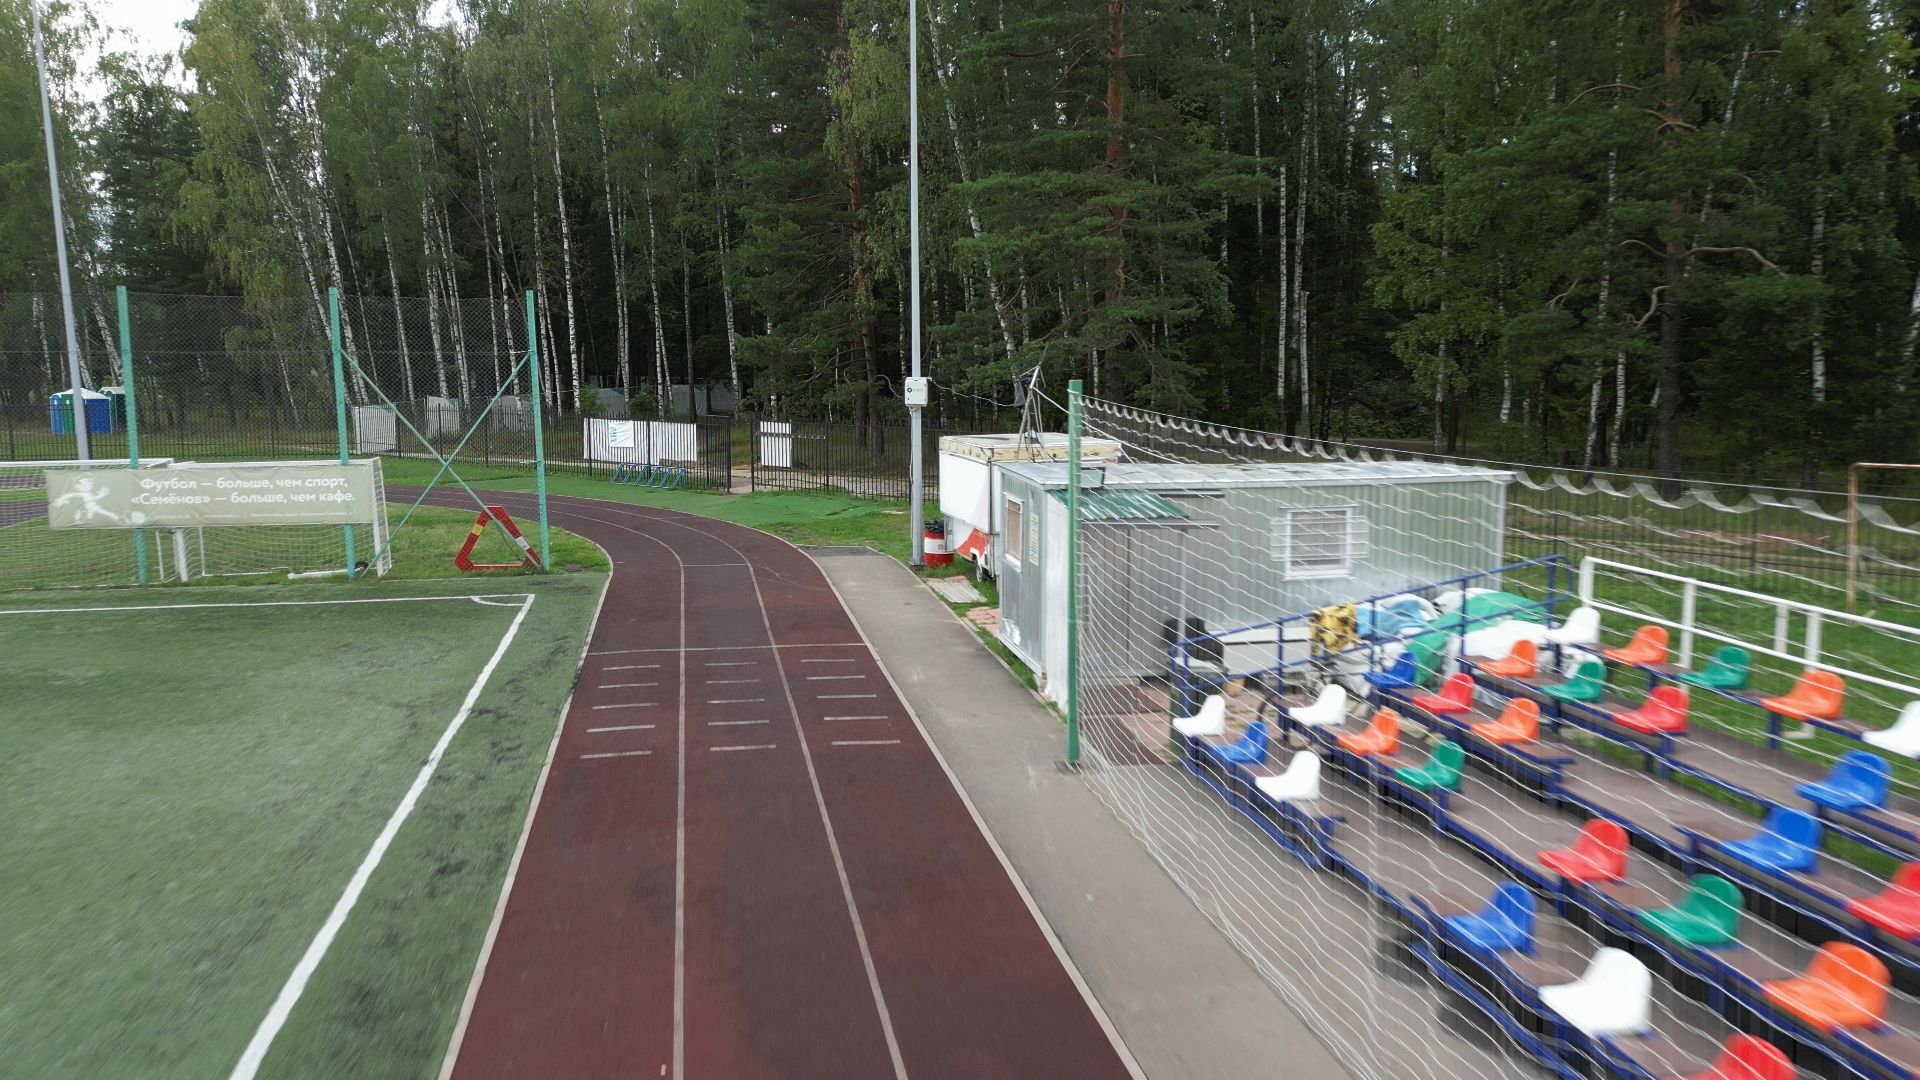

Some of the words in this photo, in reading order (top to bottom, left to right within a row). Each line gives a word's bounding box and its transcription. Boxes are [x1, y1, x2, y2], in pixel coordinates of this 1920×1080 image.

[140, 478, 197, 492] Футбол
[216, 477, 274, 490] больше,
[276, 479, 302, 488] чем
[305, 478, 349, 489] спорт,
[130, 492, 211, 505] «Семёнов»
[230, 491, 288, 504] больше,
[289, 493, 316, 502] чем
[319, 489, 356, 504] кафе.
